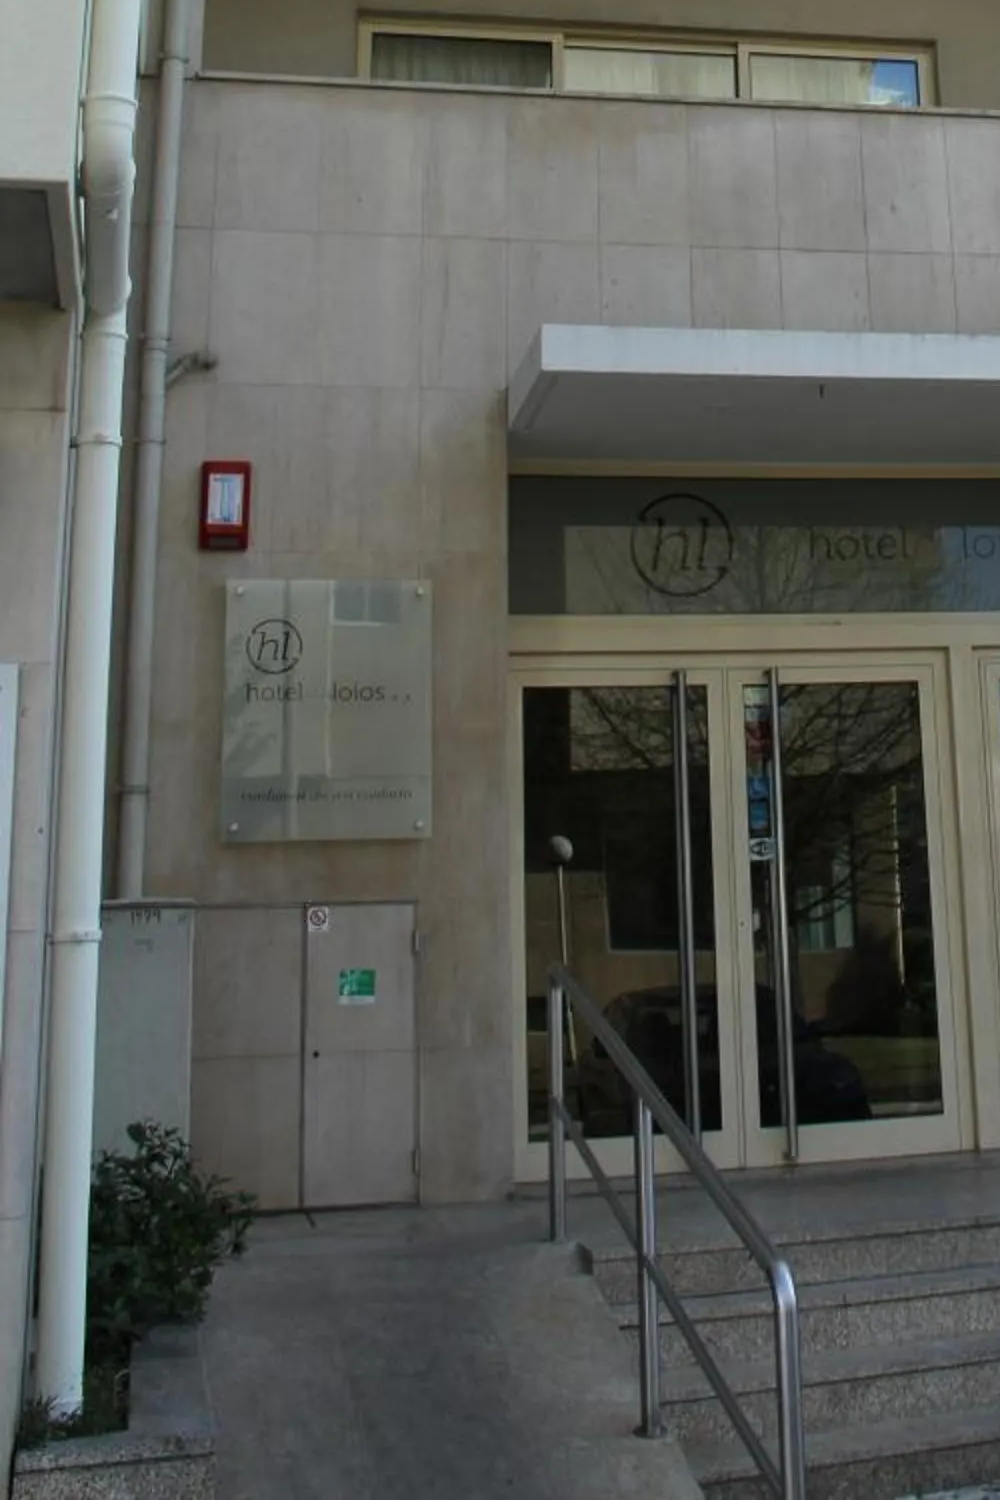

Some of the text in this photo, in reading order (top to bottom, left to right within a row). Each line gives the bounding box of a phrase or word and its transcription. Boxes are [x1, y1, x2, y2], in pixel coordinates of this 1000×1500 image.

[808, 525, 912, 562] hotel
[245, 681, 386, 702] hotel loios
